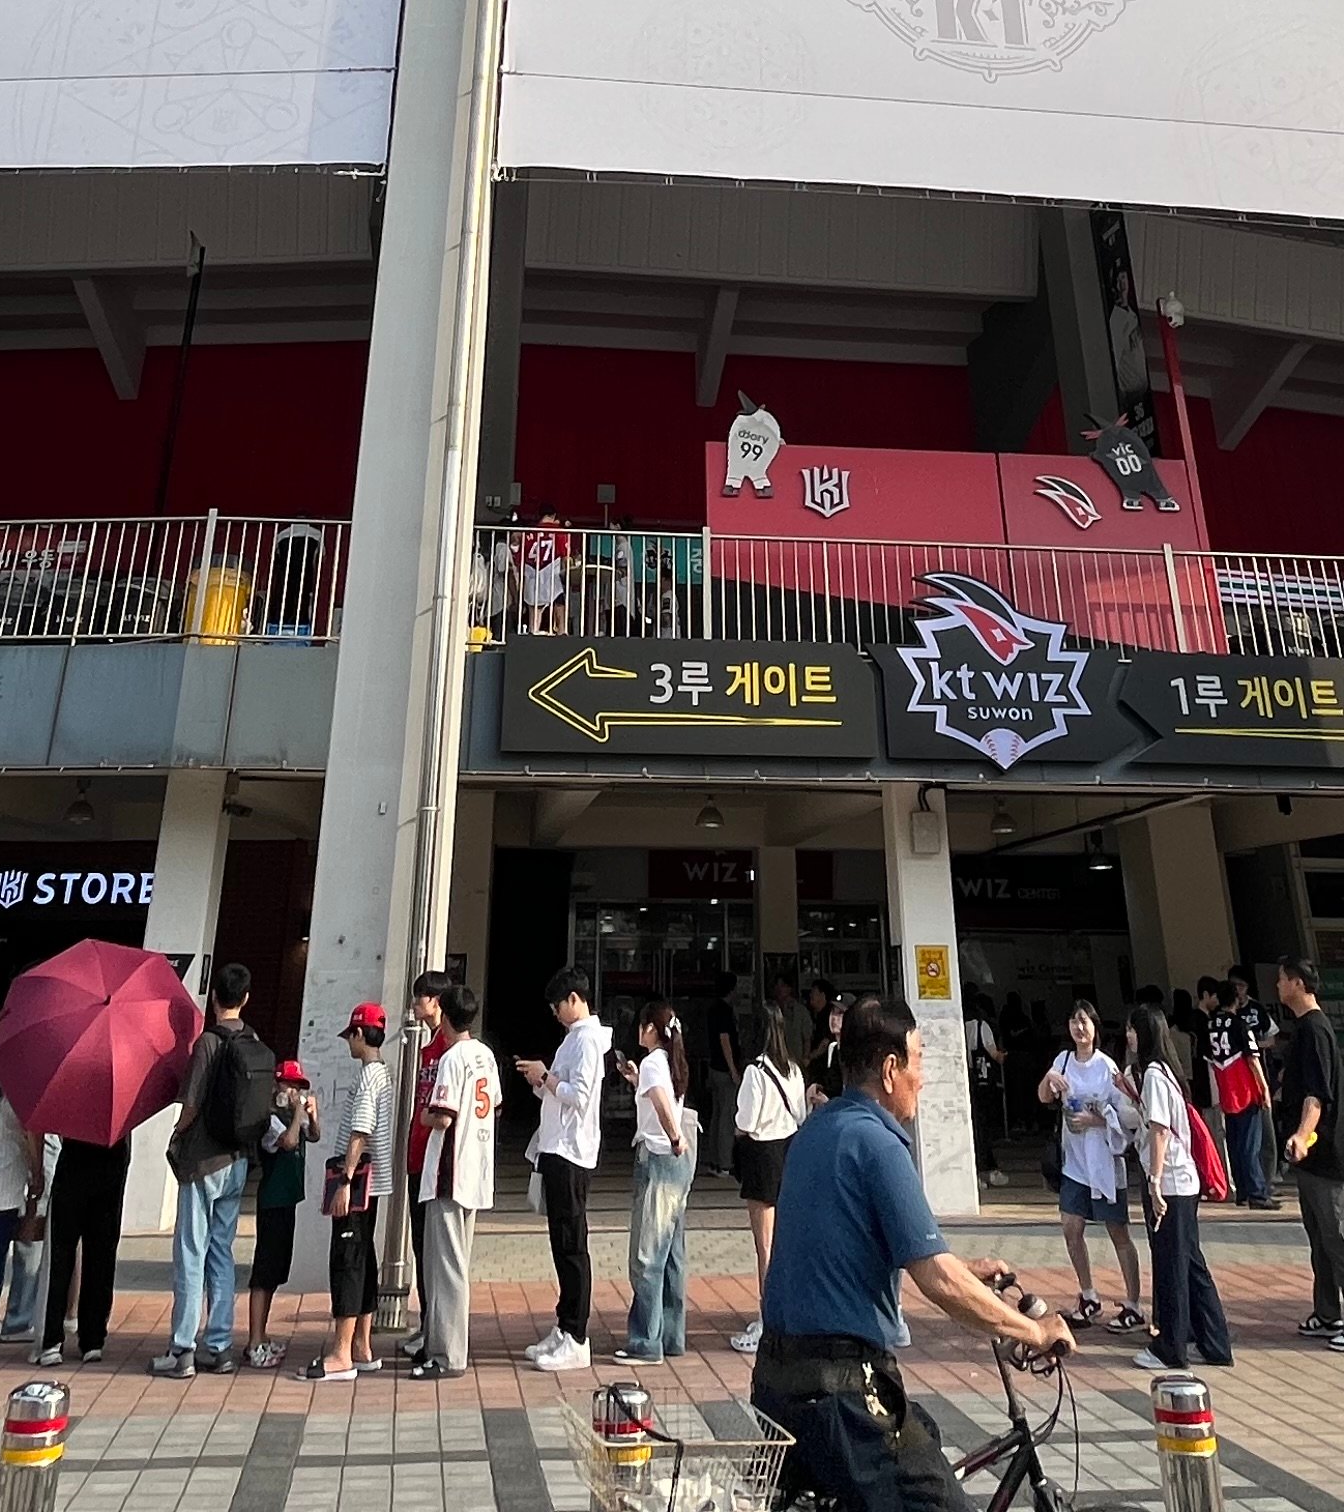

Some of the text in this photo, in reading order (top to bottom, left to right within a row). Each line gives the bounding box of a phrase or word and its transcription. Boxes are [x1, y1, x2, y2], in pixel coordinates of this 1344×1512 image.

[740, 441, 763, 461] 99
[1111, 442, 1134, 455] vic
[1115, 454, 1142, 476] 00
[529, 539, 553, 562] 47
[649, 662, 837, 707] 3루 게이트
[930, 660, 977, 701] kt
[1170, 676, 1344, 720] 1루 게이트
[966, 705, 1033, 723] suwon
[682, 861, 739, 883] WIZ
[33, 872, 156, 905] STORE
[955, 877, 1012, 900] WIZ
[1209, 1030, 1232, 1056] 54
[474, 1077, 491, 1119] 5
